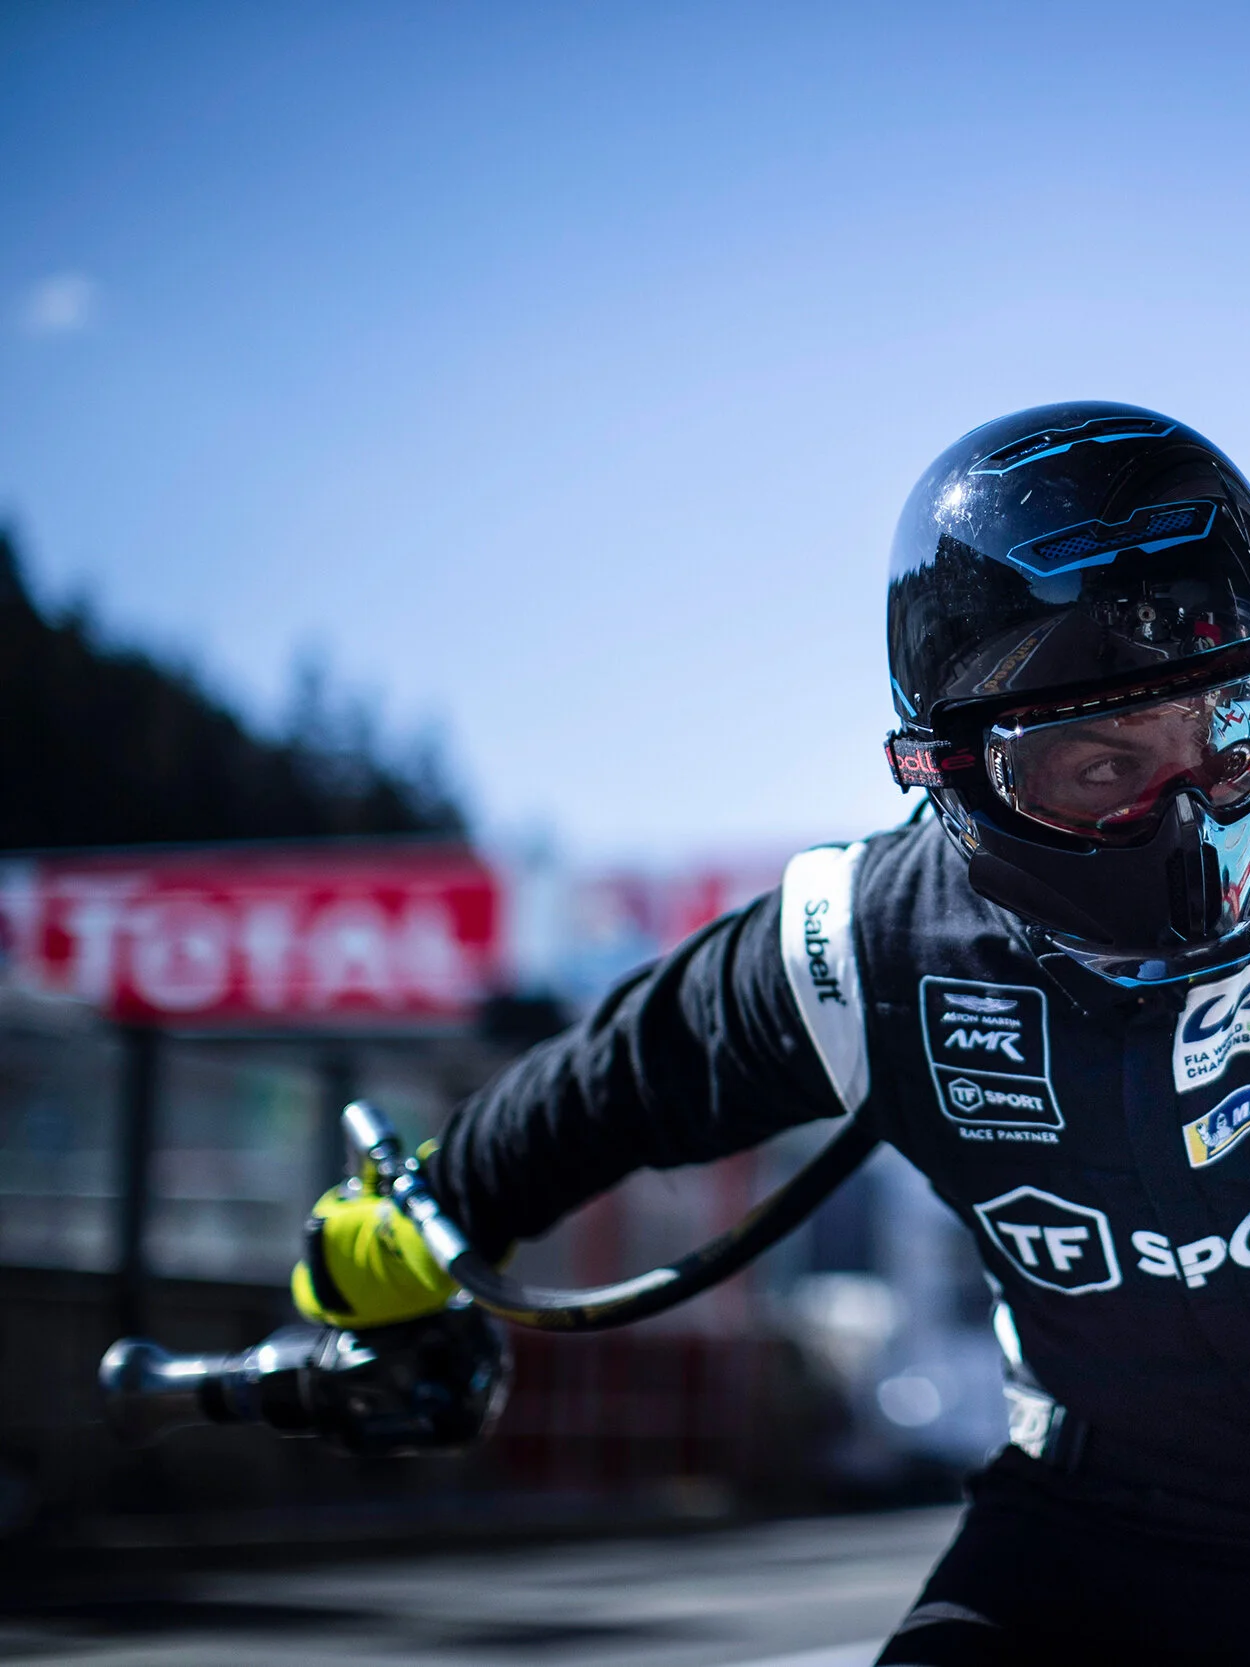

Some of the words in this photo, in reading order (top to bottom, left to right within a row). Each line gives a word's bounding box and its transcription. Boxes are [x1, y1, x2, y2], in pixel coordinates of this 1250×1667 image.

[804, 899, 847, 1006] Sabelt
[981, 1015, 1021, 1028] MARTIN
[943, 1028, 1025, 1062] AMR
[1184, 1054, 1209, 1066] FIA
[953, 1087, 976, 1101] TF
[984, 1090, 1044, 1112] SPORT
[959, 1126, 994, 1141] RACE
[997, 1129, 1059, 1144] PARTNER
[996, 1221, 1089, 1272] TF
